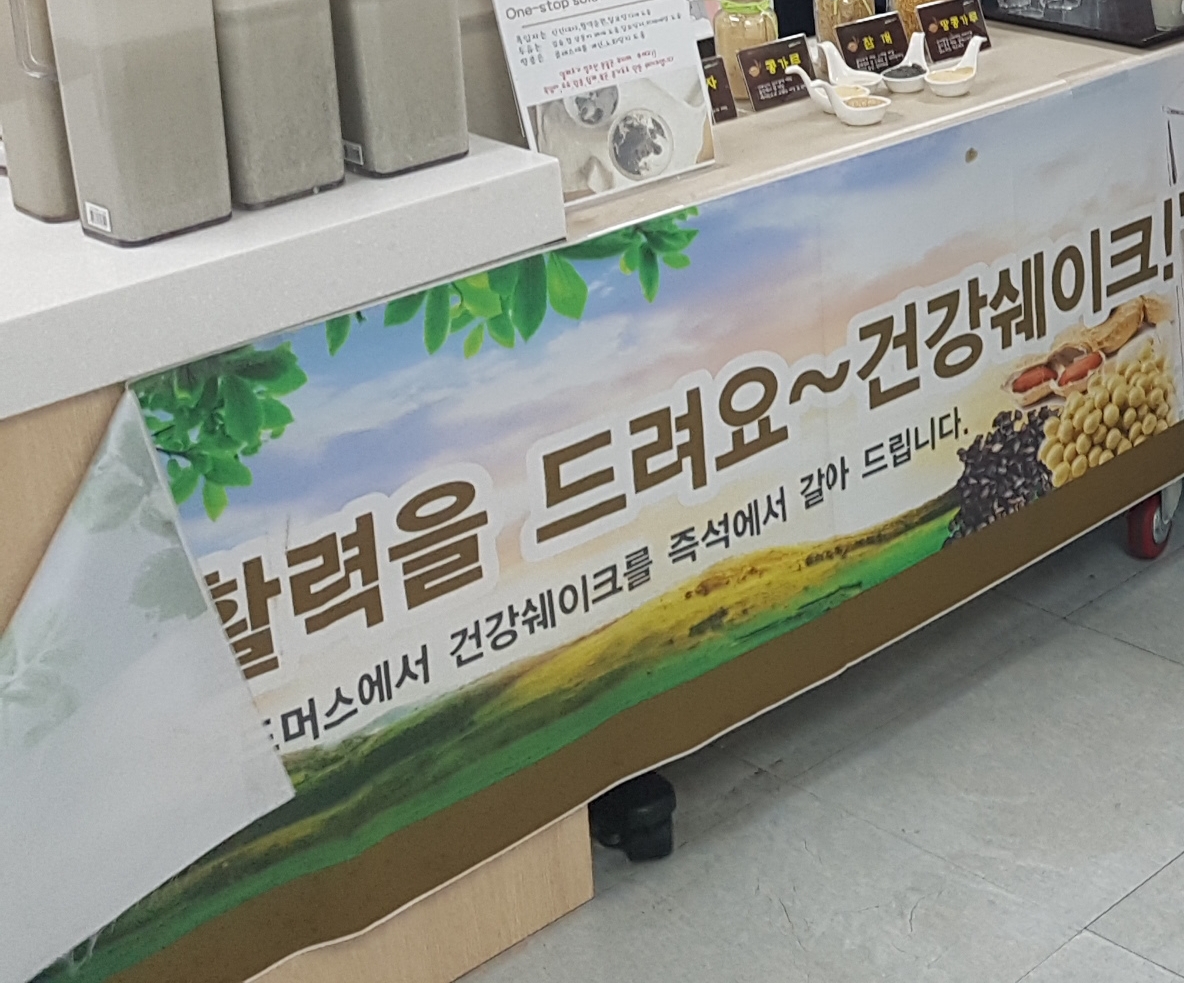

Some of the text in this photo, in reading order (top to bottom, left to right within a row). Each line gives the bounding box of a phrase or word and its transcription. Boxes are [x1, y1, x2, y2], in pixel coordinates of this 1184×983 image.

[449, 546, 653, 668] 건강쉐이크를
[668, 487, 787, 565] 즉석에서
[800, 456, 850, 510] 갈아
[861, 406, 968, 479] 드립니다.
